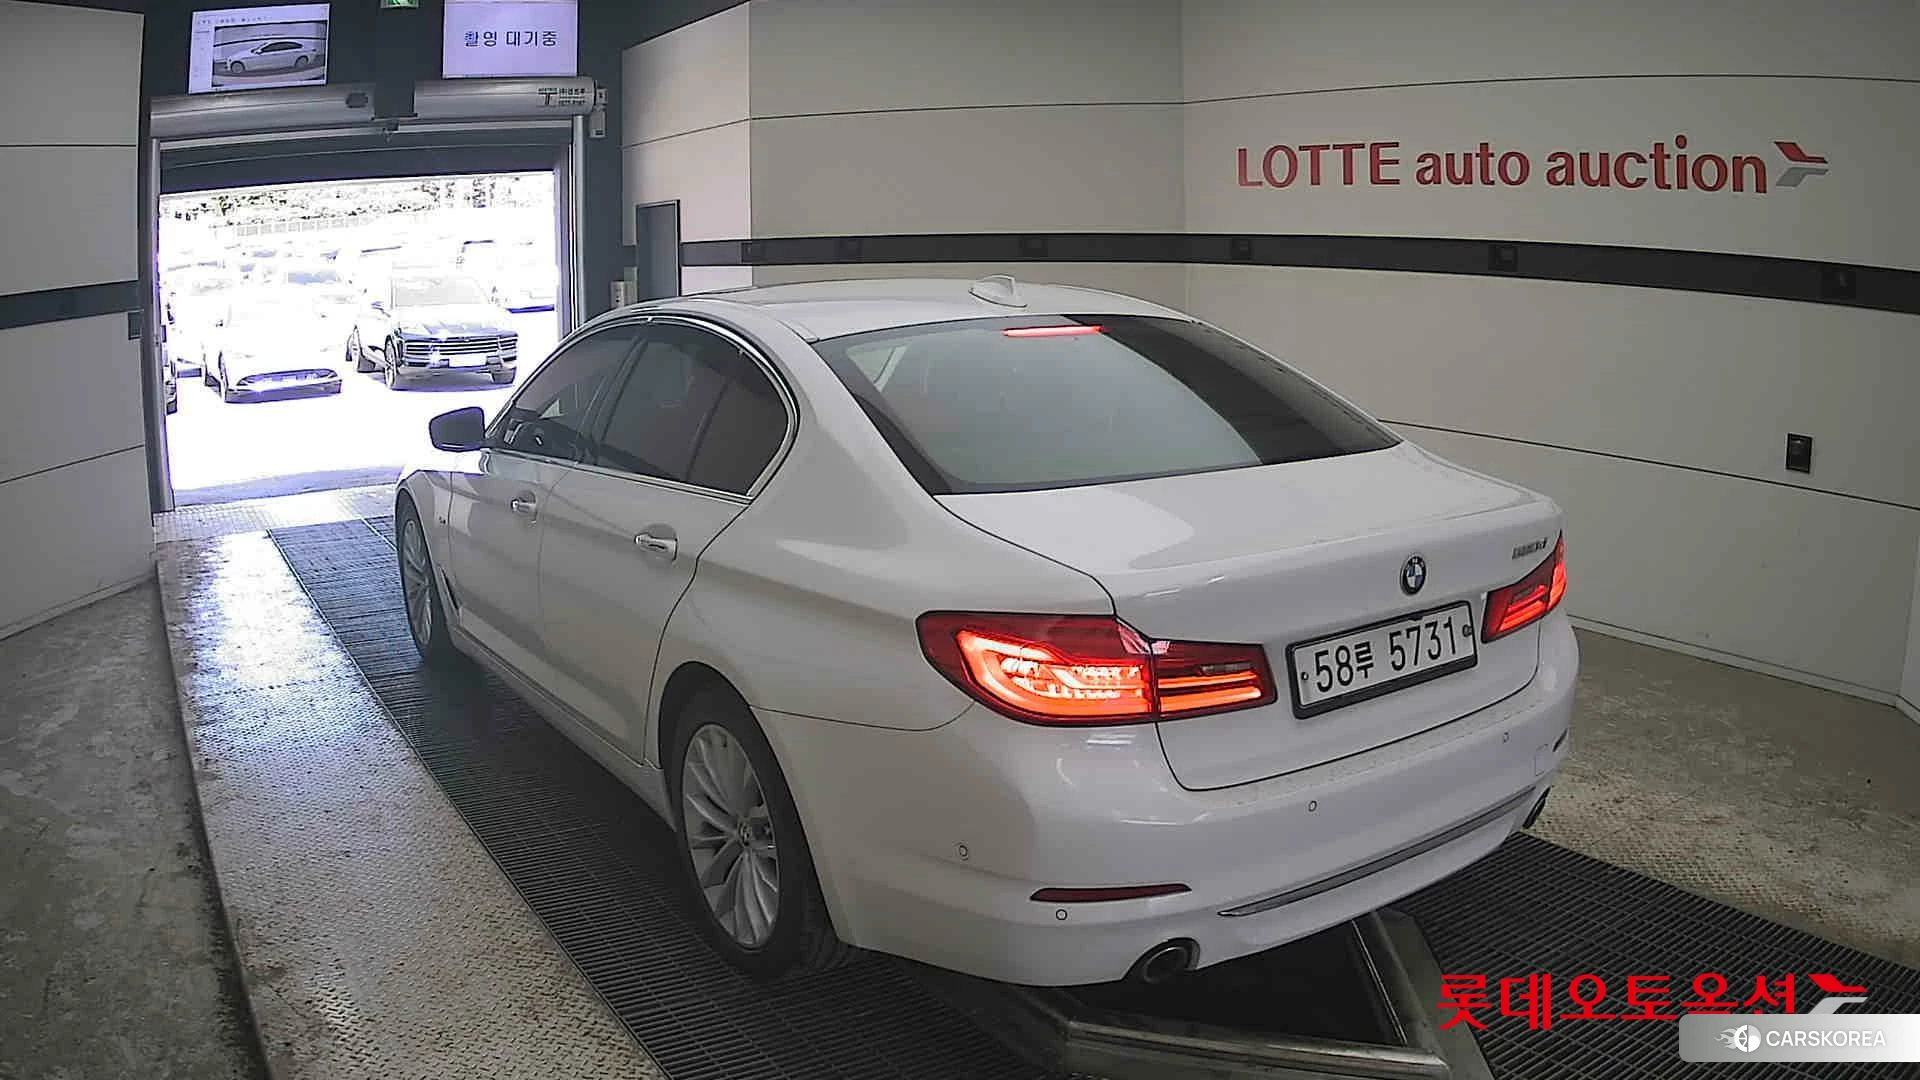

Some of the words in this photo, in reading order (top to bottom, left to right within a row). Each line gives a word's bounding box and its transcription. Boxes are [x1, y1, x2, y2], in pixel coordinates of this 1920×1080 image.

[506, 31, 557, 47] 대기중
[1237, 141, 1400, 188] LOTTE
[1415, 143, 1531, 187] auto
[1544, 135, 1767, 193] auction
[1314, 641, 1374, 692] 58루
[1389, 616, 1456, 671] 5731
